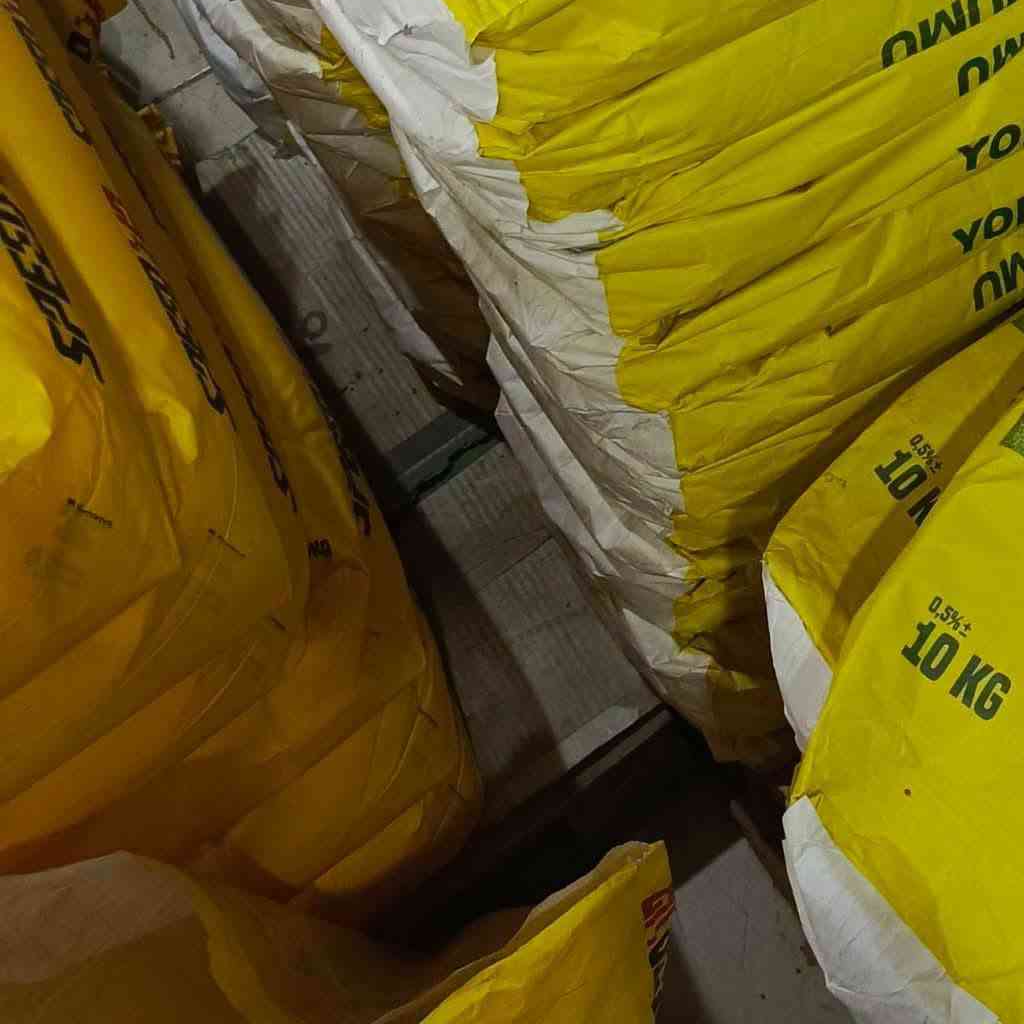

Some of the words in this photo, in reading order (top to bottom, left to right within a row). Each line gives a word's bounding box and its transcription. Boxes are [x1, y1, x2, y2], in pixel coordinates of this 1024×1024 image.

[873, 448, 928, 501] 10
[907, 486, 942, 526] K
[901, 621, 960, 682] 10
[949, 654, 1012, 720] KG
